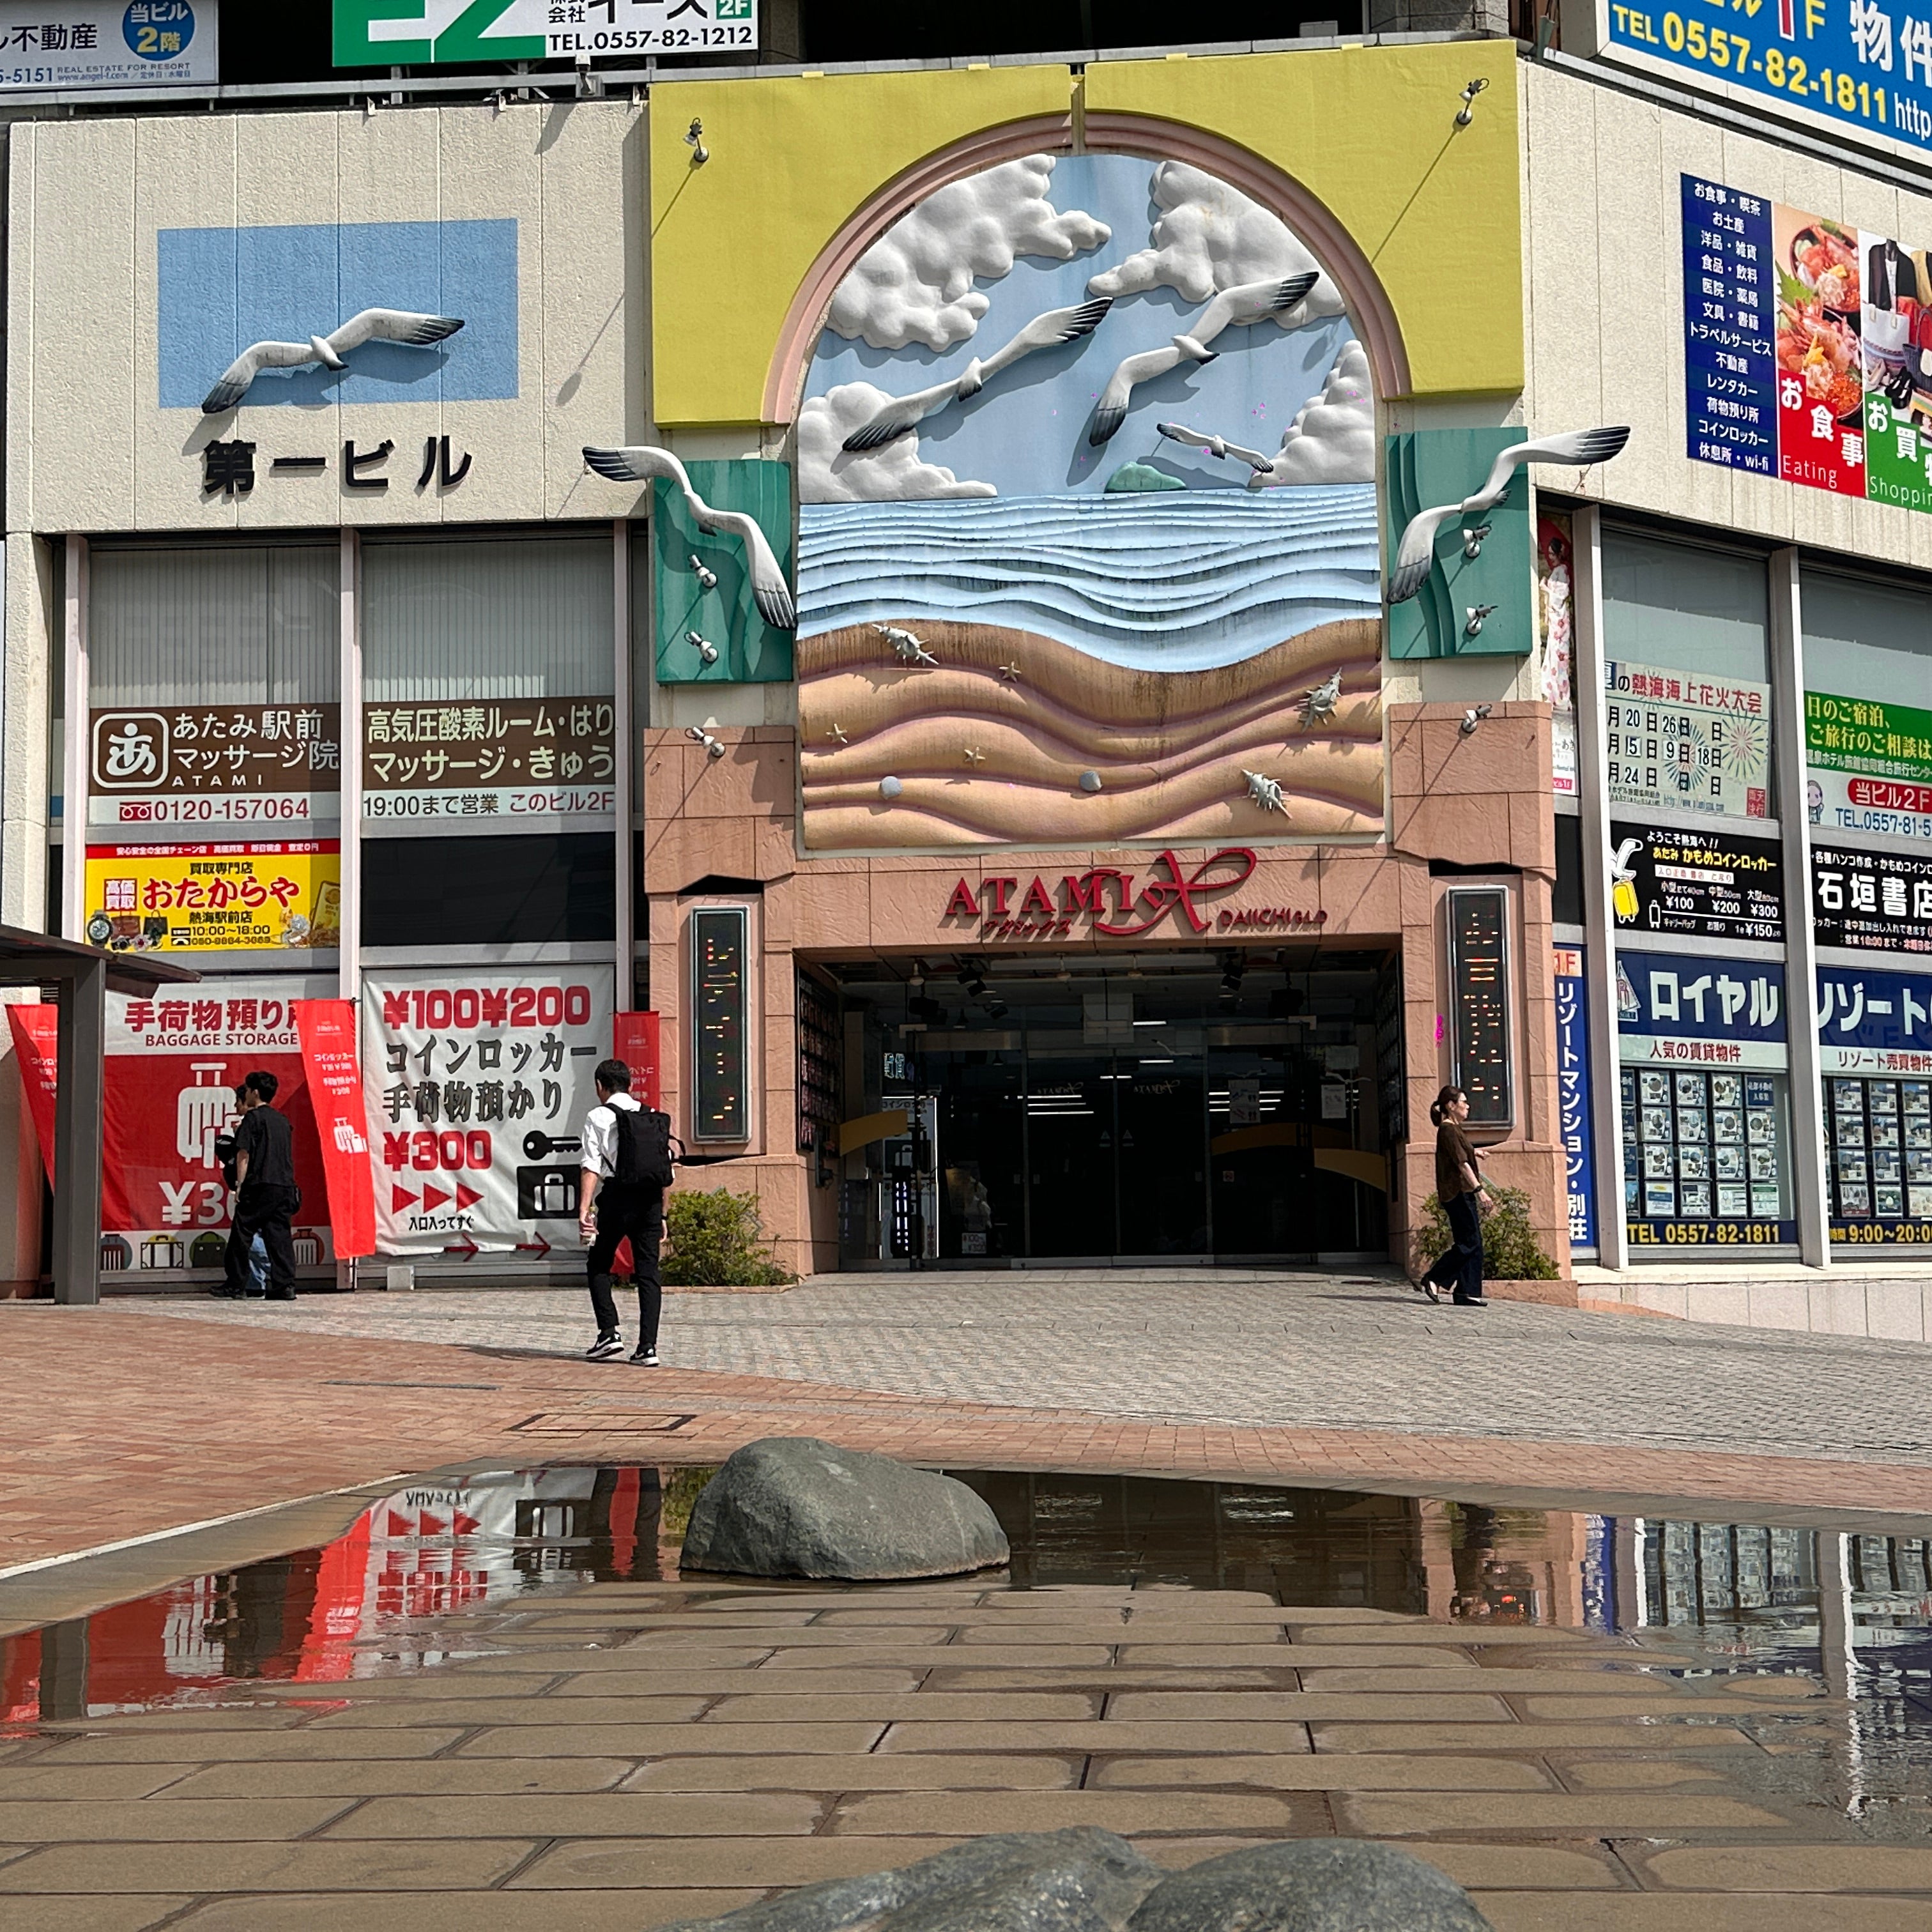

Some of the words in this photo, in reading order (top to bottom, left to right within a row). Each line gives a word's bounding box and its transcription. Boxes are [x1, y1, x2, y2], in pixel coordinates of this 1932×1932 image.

[130, 3, 188, 23] 当ビル
[137, 26, 180, 52] 2階
[549, 26, 752, 50] TEL.0557-82-1212
[1613, 5, 1660, 44] TEL
[1662, 12, 1886, 123] 0557-82-1811
[1712, 211, 1745, 234] お土産
[1690, 322, 1772, 356] トラベルサービス
[1715, 351, 1749, 374] 不動産
[1707, 373, 1758, 396] レンタカー
[1699, 419, 1768, 445] コインロッカー
[204, 435, 472, 495] 第一ビル
[1782, 455, 1837, 489] Eating
[173, 709, 324, 740] あたみ駅前
[367, 703, 614, 744] 高気圧酸素ルーム・はり
[1810, 723, 1932, 760] ご旅行のご相談は
[173, 740, 340, 770] マッサージ院
[369, 744, 614, 782] マッサージ・きゅう
[172, 774, 263, 787] ATAMI
[364, 793, 499, 816] 19:00まで営業
[510, 791, 615, 813] このビル2F
[1855, 781, 1930, 811] 当ビル2F
[155, 798, 309, 821] 0120-157064
[142, 876, 300, 909] おたからや
[1818, 872, 1932, 918] 石垣書店
[189, 910, 253, 924] 熱海駅前店
[1666, 895, 1694, 910] ¥100
[1712, 900, 1740, 914] ¥200
[1751, 904, 1778, 917] ¥300
[1650, 971, 1778, 1027] ロイヤル
[146, 1034, 221, 1047] BAGGAGE
[226, 1032, 298, 1046] STORAGE
[1650, 1040, 1742, 1063] 人気の賃貸物件
[385, 1033, 597, 1075] コインロッカー
[1838, 1051, 1932, 1073] リゾート売買物件
[383, 1078, 562, 1123] 手荷物預かり
[383, 1130, 491, 1172] ¥300
[158, 1181, 235, 1224] ¥3
[409, 1216, 475, 1230] 入口入ってすぐ
[1627, 1224, 1660, 1243] TEL
[1849, 1224, 1932, 1243] 9:00~20:0
